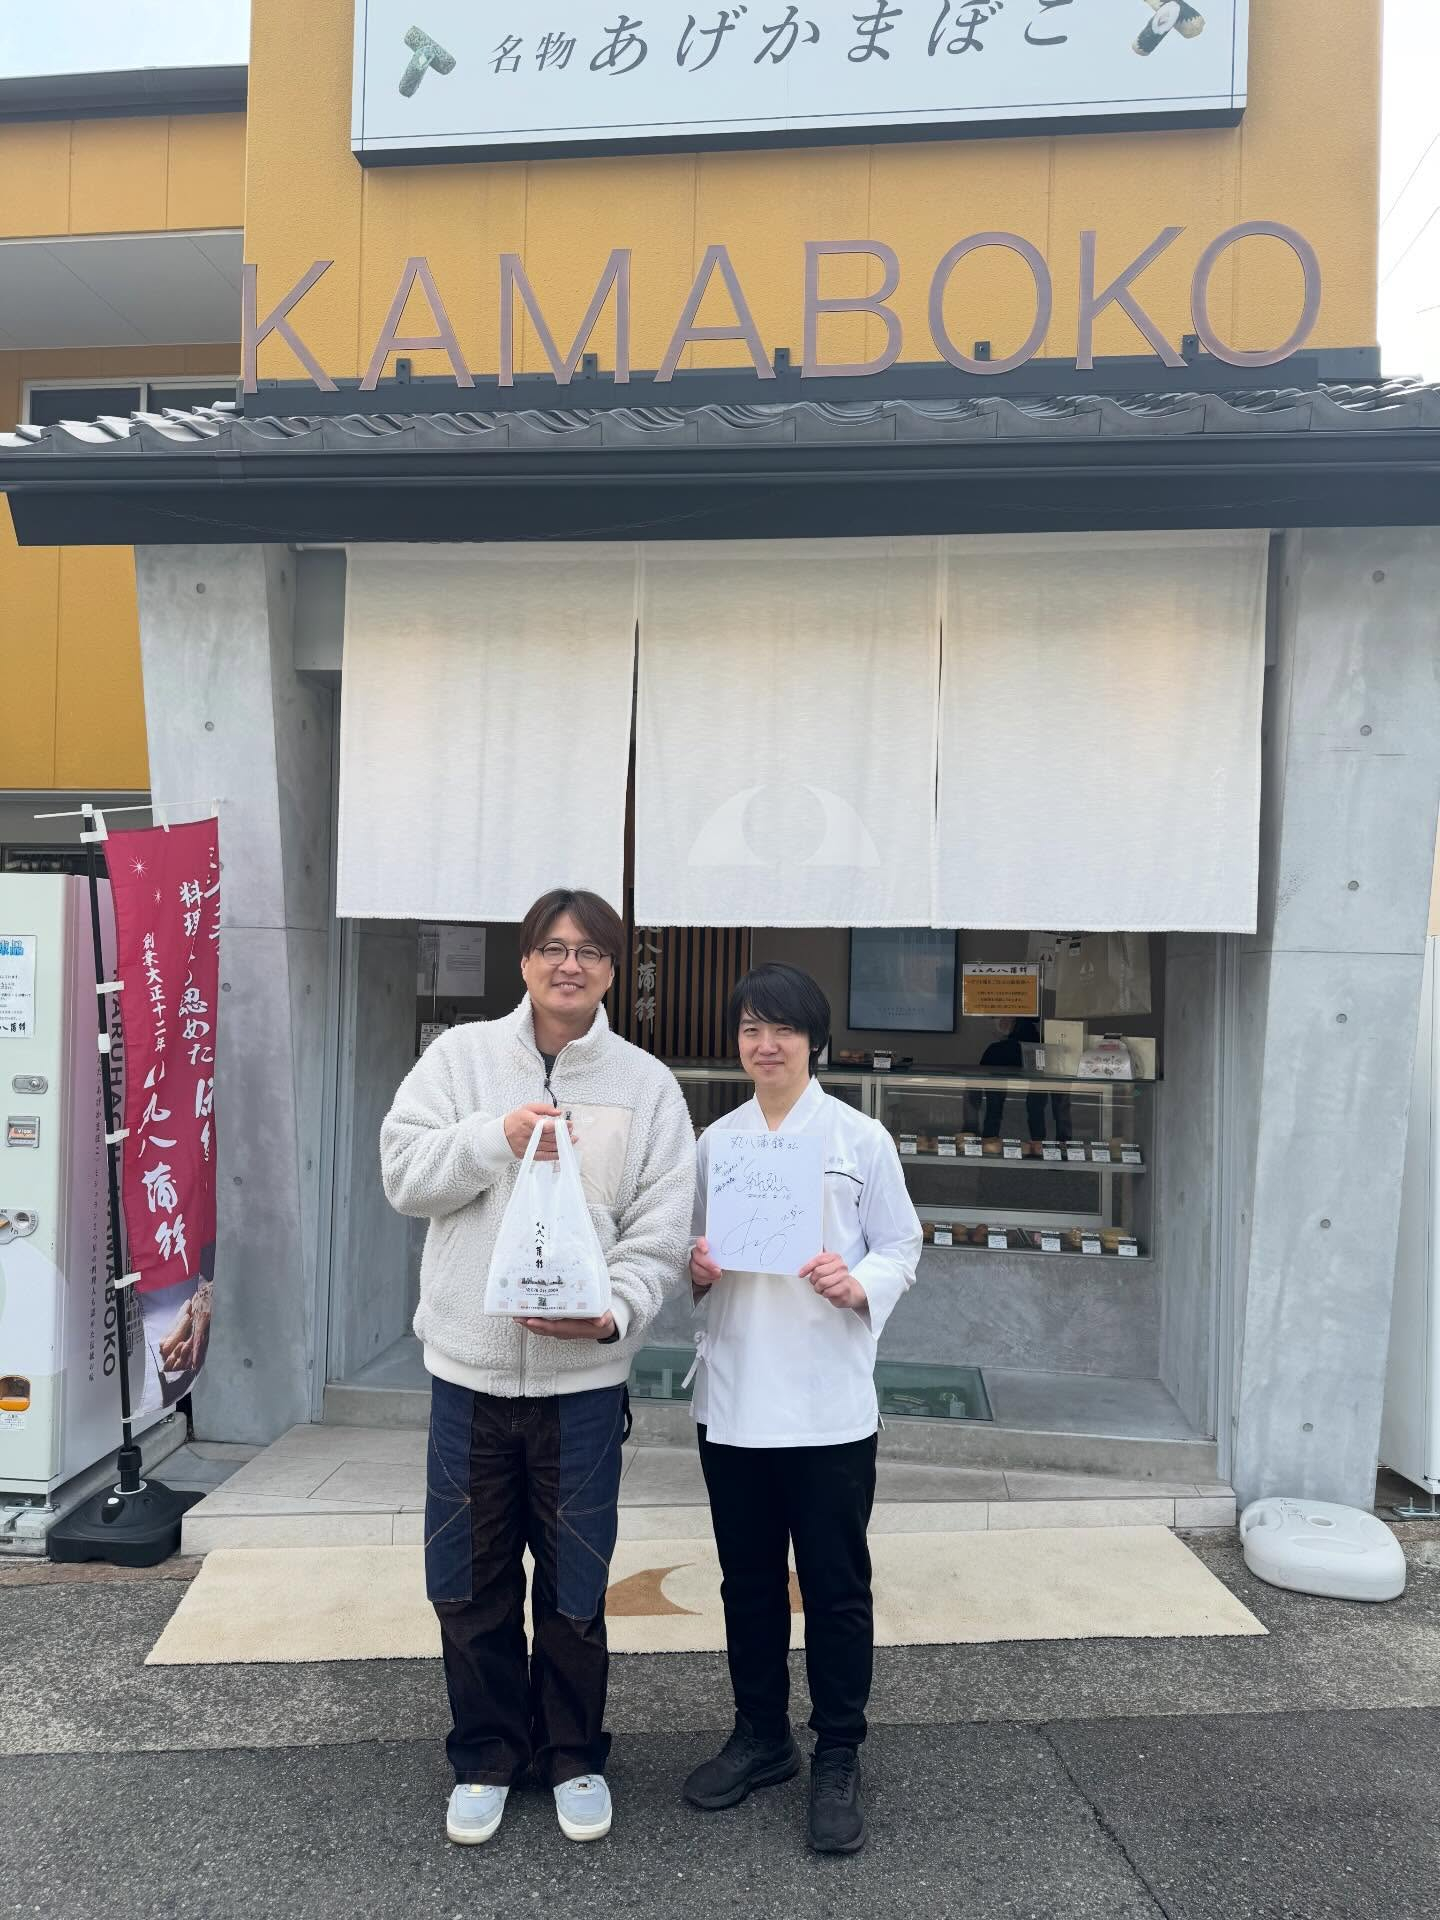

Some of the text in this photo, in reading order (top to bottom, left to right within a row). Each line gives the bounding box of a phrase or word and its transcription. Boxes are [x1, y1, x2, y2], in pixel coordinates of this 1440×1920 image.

[487, 0, 1074, 76] 名物 あげかまぼこ
[242, 219, 1322, 394] KAMABOKO
[142, 932, 168, 1052] 創業大正十二年
[634, 927, 663, 1034] 八蒲鉾
[137, 1091, 189, 1276] 丸八蒲鉾
